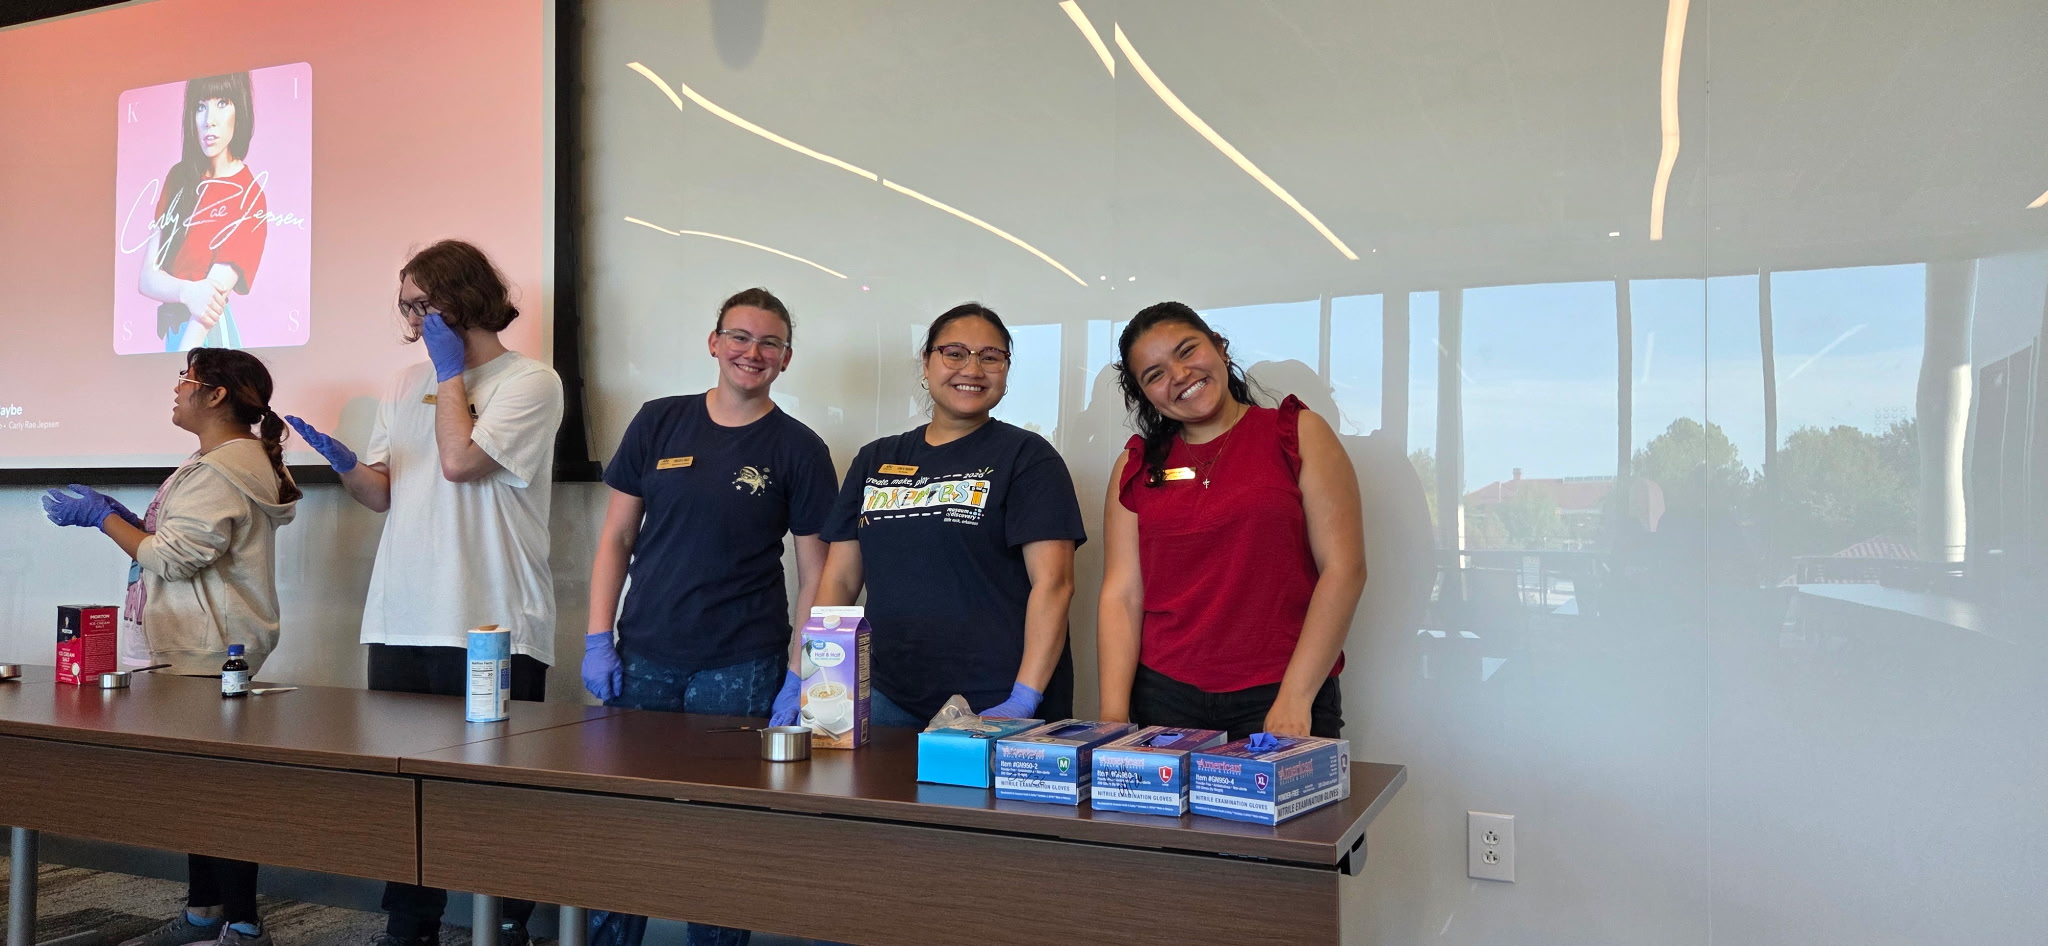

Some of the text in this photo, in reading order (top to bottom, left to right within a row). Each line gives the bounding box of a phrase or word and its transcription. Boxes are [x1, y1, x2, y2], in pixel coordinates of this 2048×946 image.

[127, 102, 140, 123] K
[120, 170, 305, 271] Carly Rae Jepsen
[288, 309, 300, 331] S
[122, 321, 133, 341] S
[0, 403, 23, 418] aybe
[8, 421, 24, 431] Carly
[24, 421, 37, 429] Rae
[37, 420, 60, 430] Jepsen
[1059, 759, 1068, 768] M
[1196, 758, 1242, 773] American
[1277, 757, 1313, 780] American
[1162, 768, 1169, 779] L
[1195, 773, 1208, 781] Item
[1257, 775, 1266, 786] XL
[1051, 784, 1070, 792] GLOVES
[1097, 790, 1117, 798] NITRILE
[1195, 794, 1268, 811] NITRILE EXAMINATION GLOVES
[1277, 803, 1295, 818] NITRILE
[1295, 793, 1323, 812] EXAMINATION
[1324, 788, 1339, 800] GLOVES
